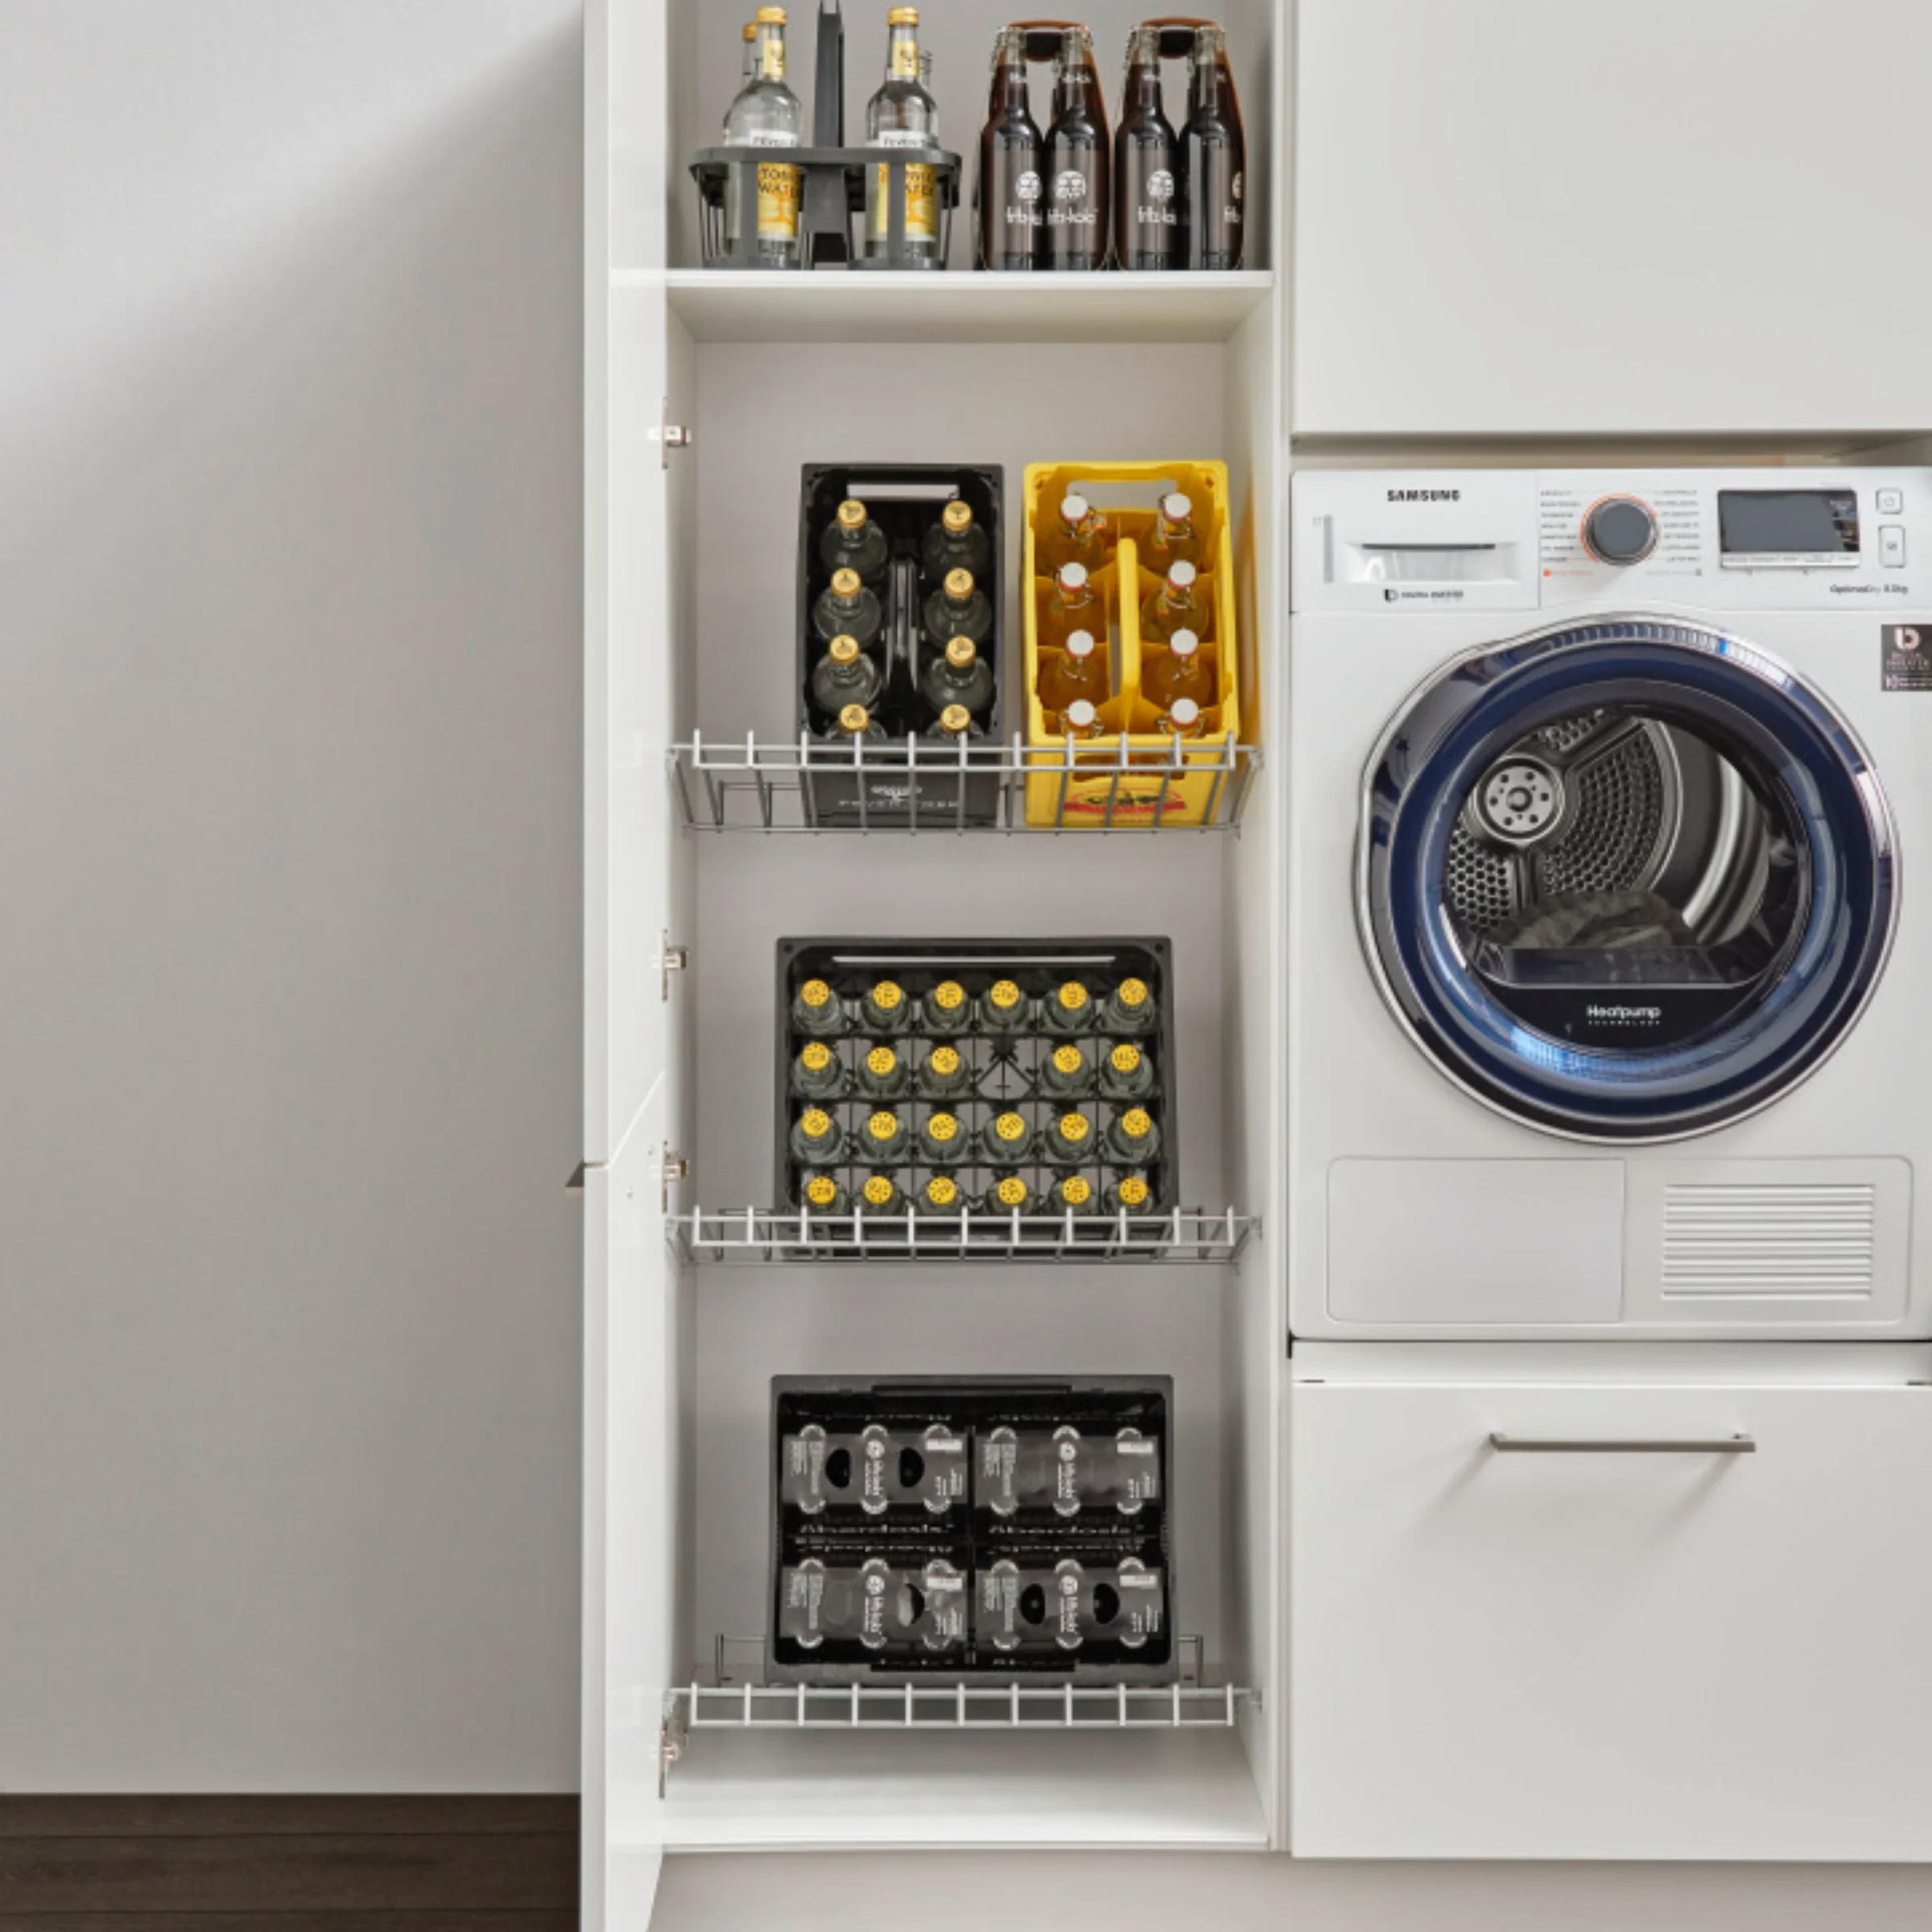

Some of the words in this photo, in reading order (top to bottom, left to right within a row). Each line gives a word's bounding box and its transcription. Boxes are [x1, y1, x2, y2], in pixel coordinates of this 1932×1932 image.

[758, 182, 799, 196] WATE
[1387, 489, 1460, 502] SAMSUNG
[1587, 1005, 1662, 1019] Heatpump
